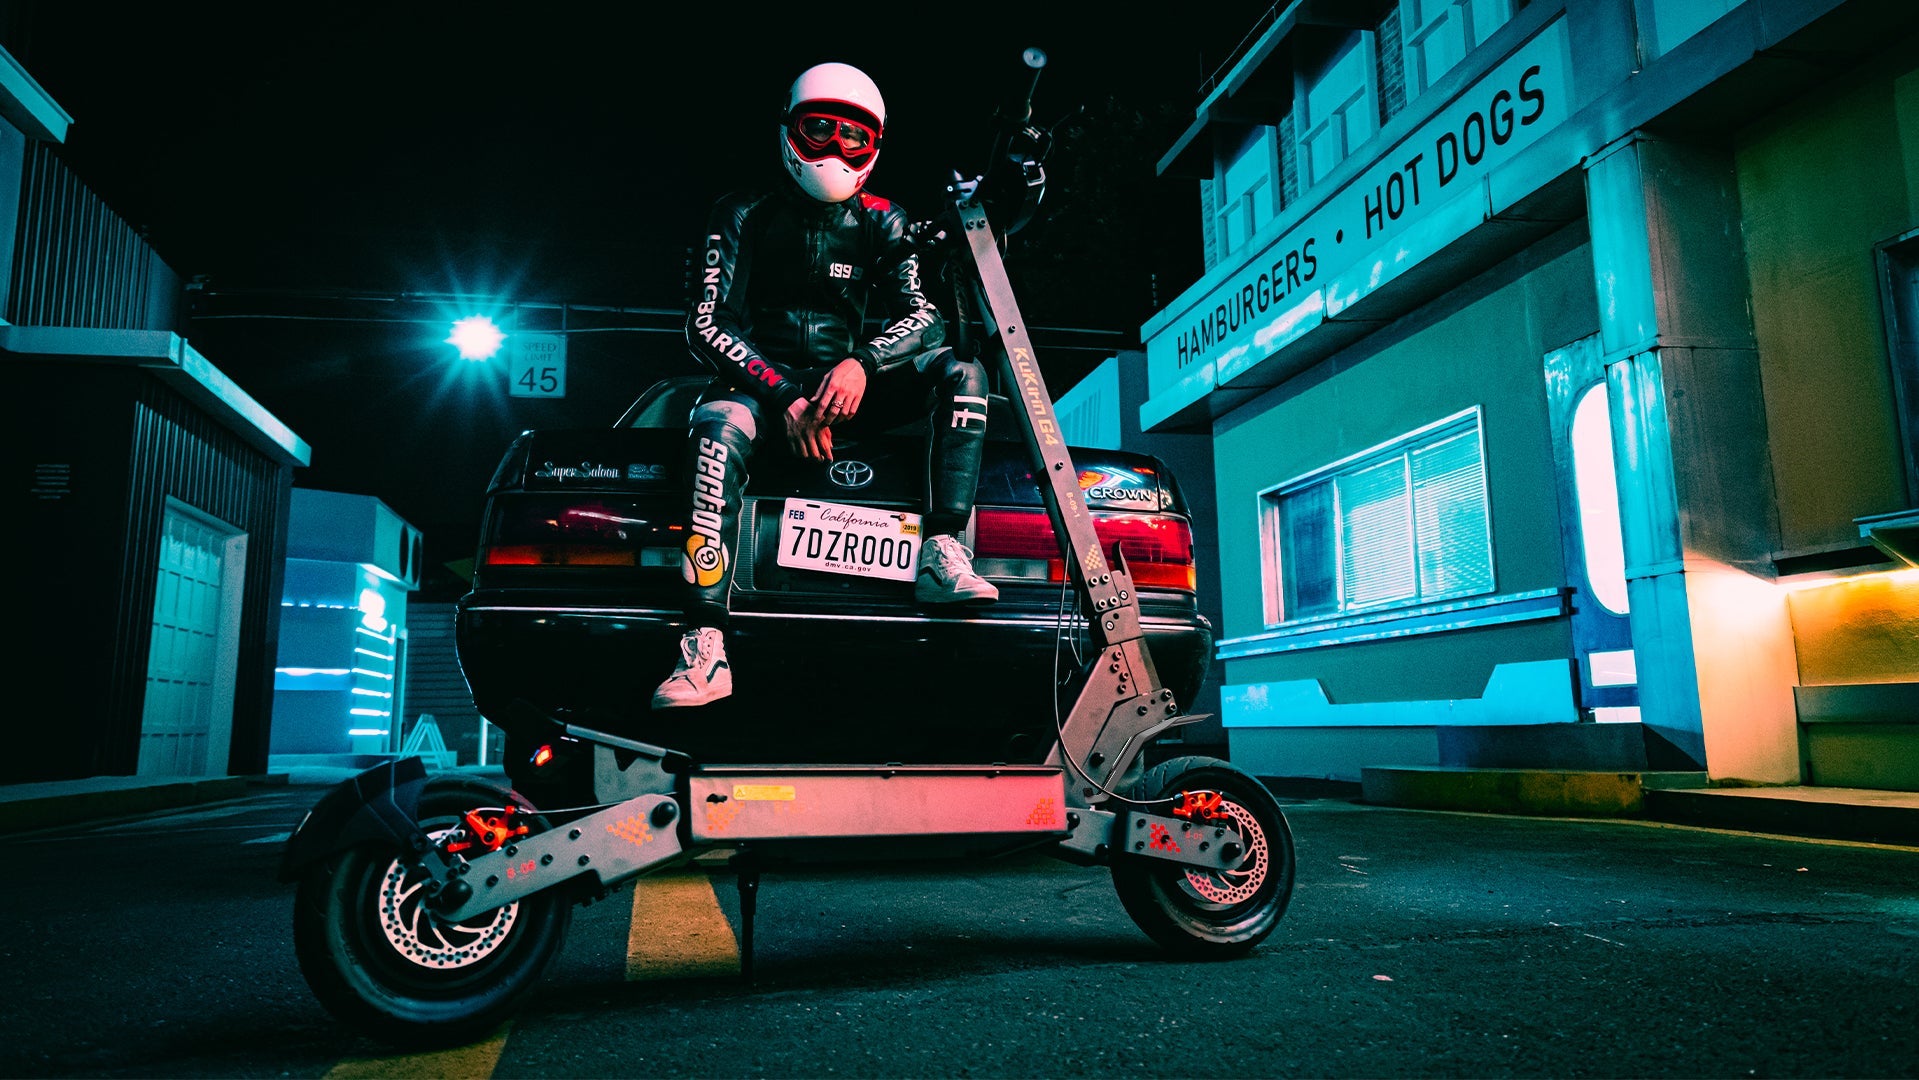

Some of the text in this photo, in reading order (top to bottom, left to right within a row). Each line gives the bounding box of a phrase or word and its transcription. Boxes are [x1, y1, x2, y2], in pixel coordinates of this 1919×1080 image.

[1177, 65, 1546, 370] HAMBURGERS HOT DOGS
[518, 366, 558, 393] 45
[1038, 418, 1059, 446] G4
[535, 461, 577, 482] Super
[575, 461, 619, 479] Saloon
[1089, 486, 1153, 502] CROWN
[788, 509, 805, 520] FEB
[820, 508, 889, 529] California
[791, 525, 912, 570] 7DZR000
[825, 561, 871, 573] dmv.ca.gov
